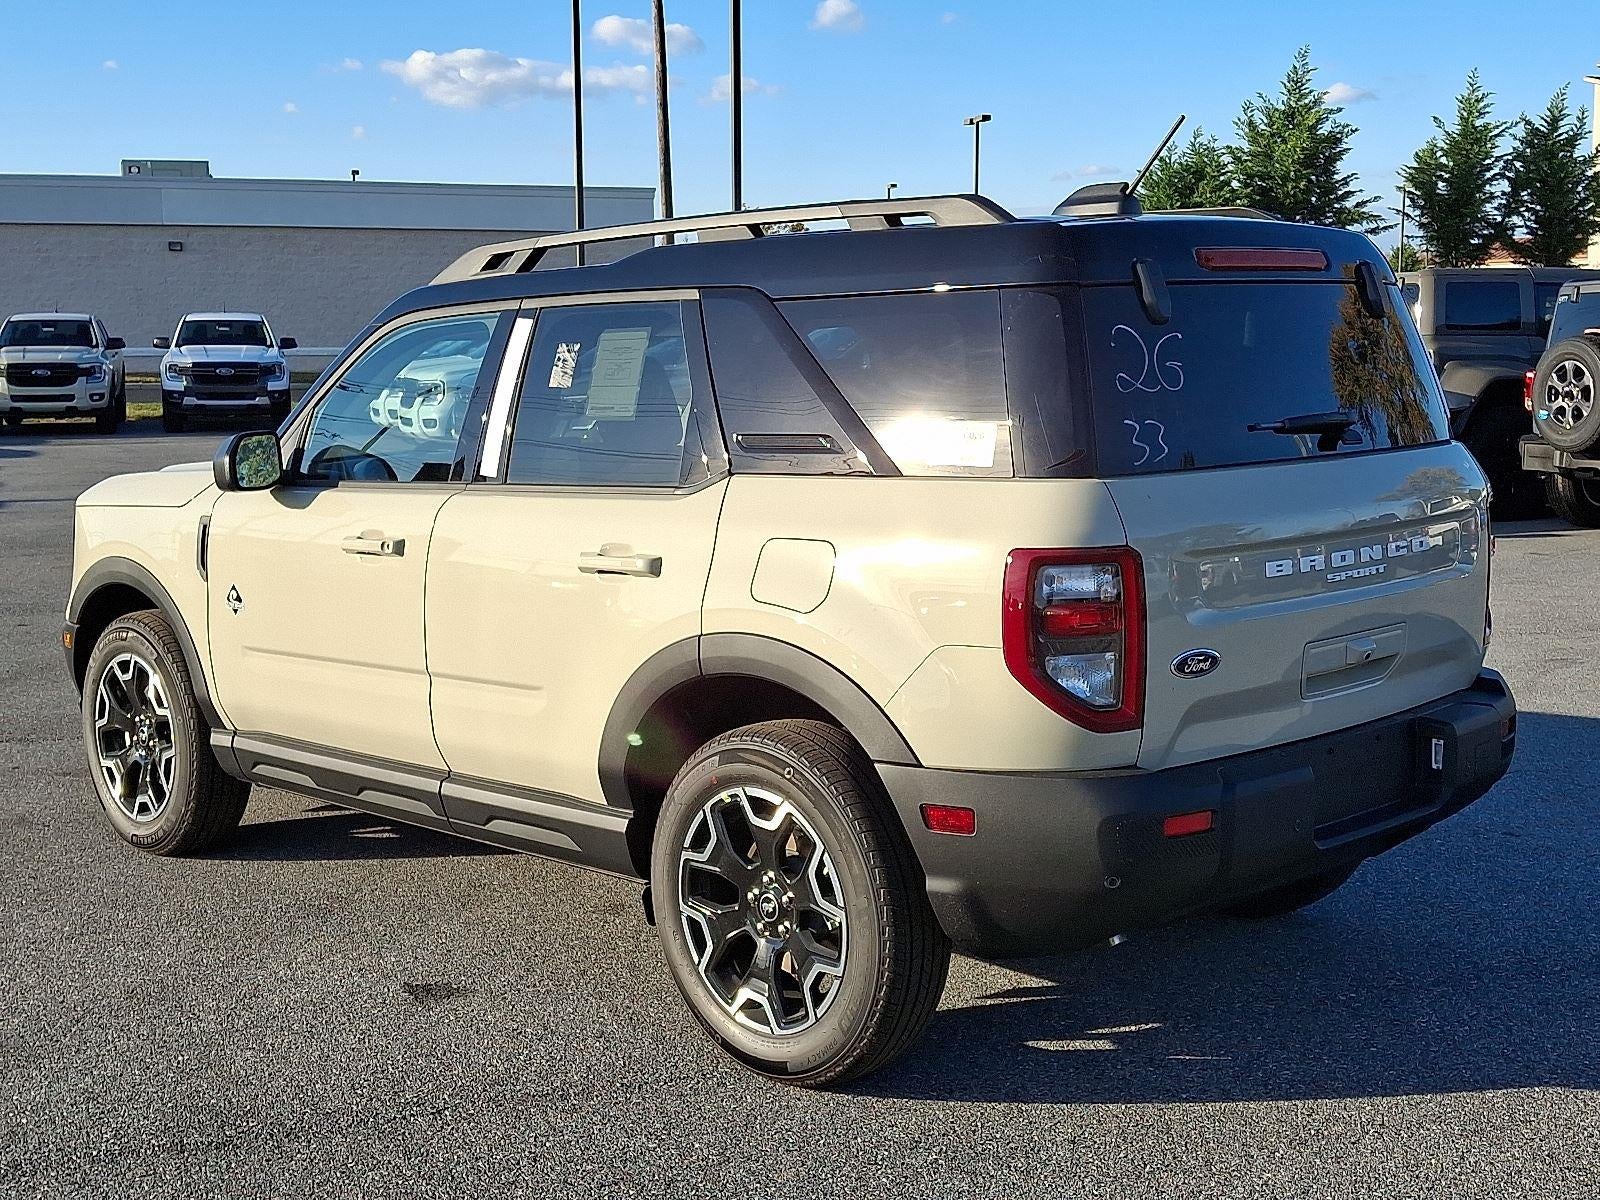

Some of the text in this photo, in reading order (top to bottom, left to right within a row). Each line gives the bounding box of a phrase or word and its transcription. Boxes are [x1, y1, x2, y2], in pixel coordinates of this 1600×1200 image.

[1122, 419, 1169, 466] 33
[1265, 535, 1431, 578] BRONCO
[1326, 563, 1388, 583] SPORT
[1184, 655, 1212, 673] Ford
[805, 1037, 839, 1064] PRIMACY
